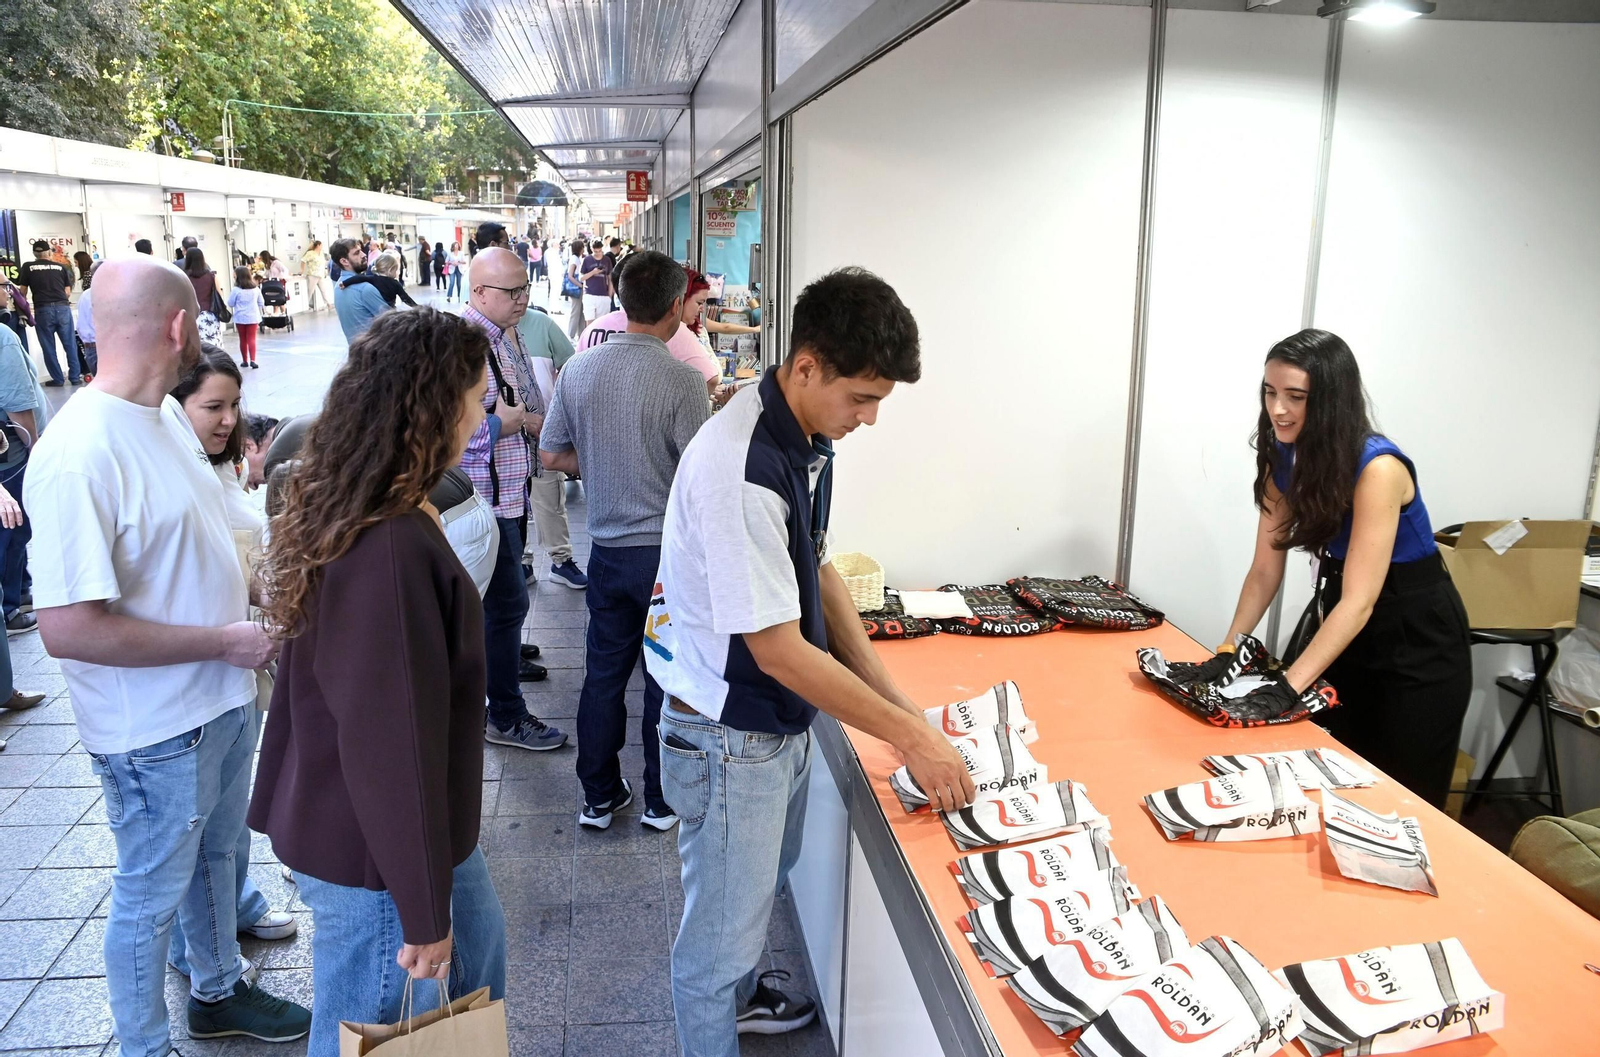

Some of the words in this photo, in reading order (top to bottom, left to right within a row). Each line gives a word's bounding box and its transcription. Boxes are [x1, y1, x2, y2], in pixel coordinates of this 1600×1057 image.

[707, 212, 727, 221] 10%
[719, 297, 750, 308] ETRAS
[1077, 606, 1134, 618] ROLDAN
[982, 621, 1040, 634] ROLDAN
[956, 701, 974, 729] LDAN
[980, 772, 1037, 792] ROLDAN
[1217, 775, 1242, 802] OLDAN
[1009, 797, 1036, 823] ROLDAN
[1246, 809, 1307, 827] ROLDAN
[1055, 898, 1084, 934] ROLDA
[1086, 928, 1131, 970] ROLDAN
[1357, 952, 1397, 995] OLDAN
[1151, 976, 1212, 1027] ROLDAN
[1161, 972, 1216, 1019] HERMANOS
[1410, 1002, 1490, 1030] ROLDAN
